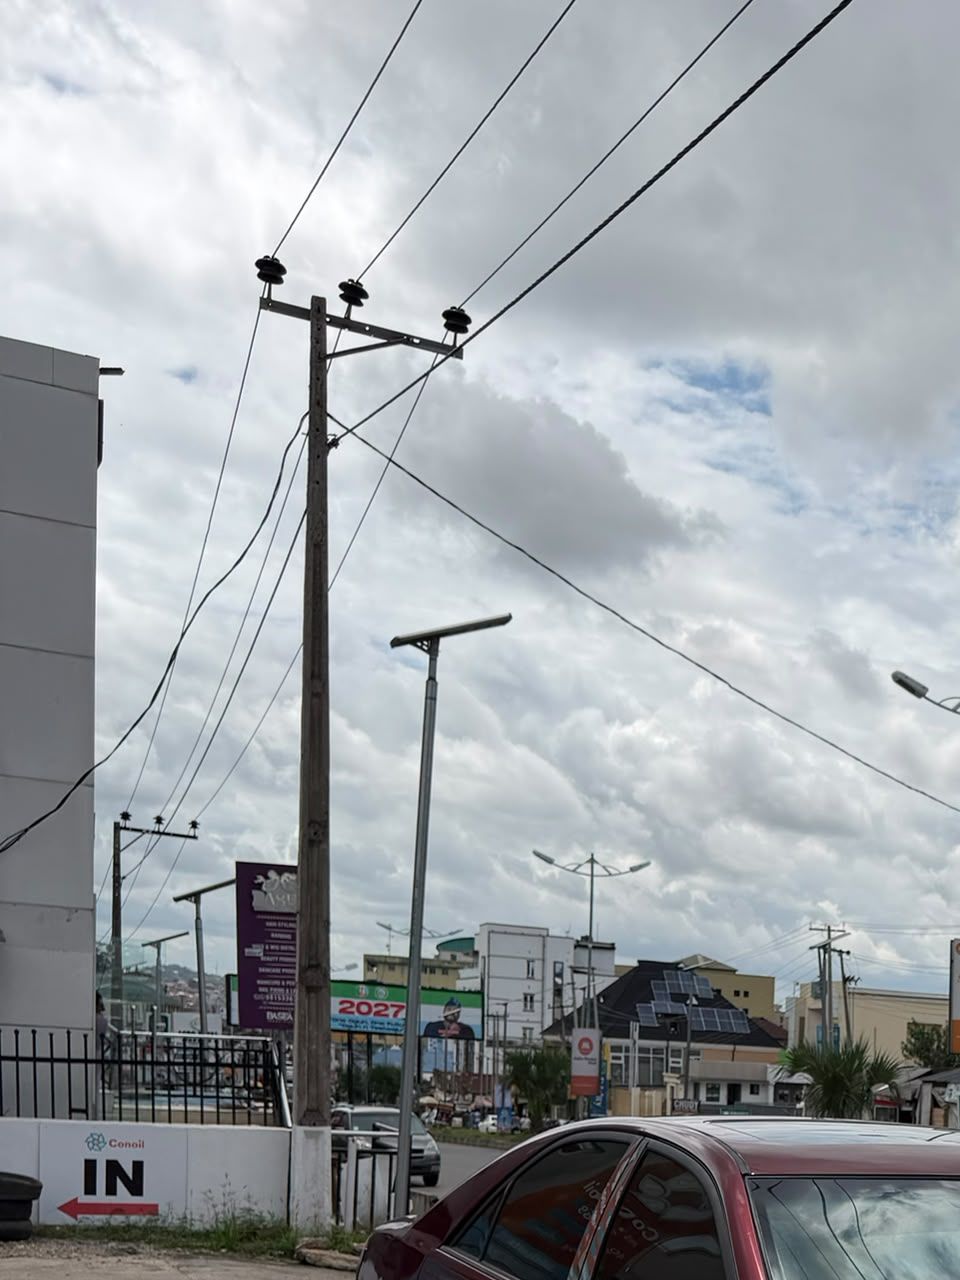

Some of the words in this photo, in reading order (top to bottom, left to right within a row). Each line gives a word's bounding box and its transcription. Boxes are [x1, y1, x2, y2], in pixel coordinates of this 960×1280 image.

[338, 999, 406, 1019] 2027
[108, 1139, 145, 1149] Conoil
[84, 1158, 144, 1196] IN
